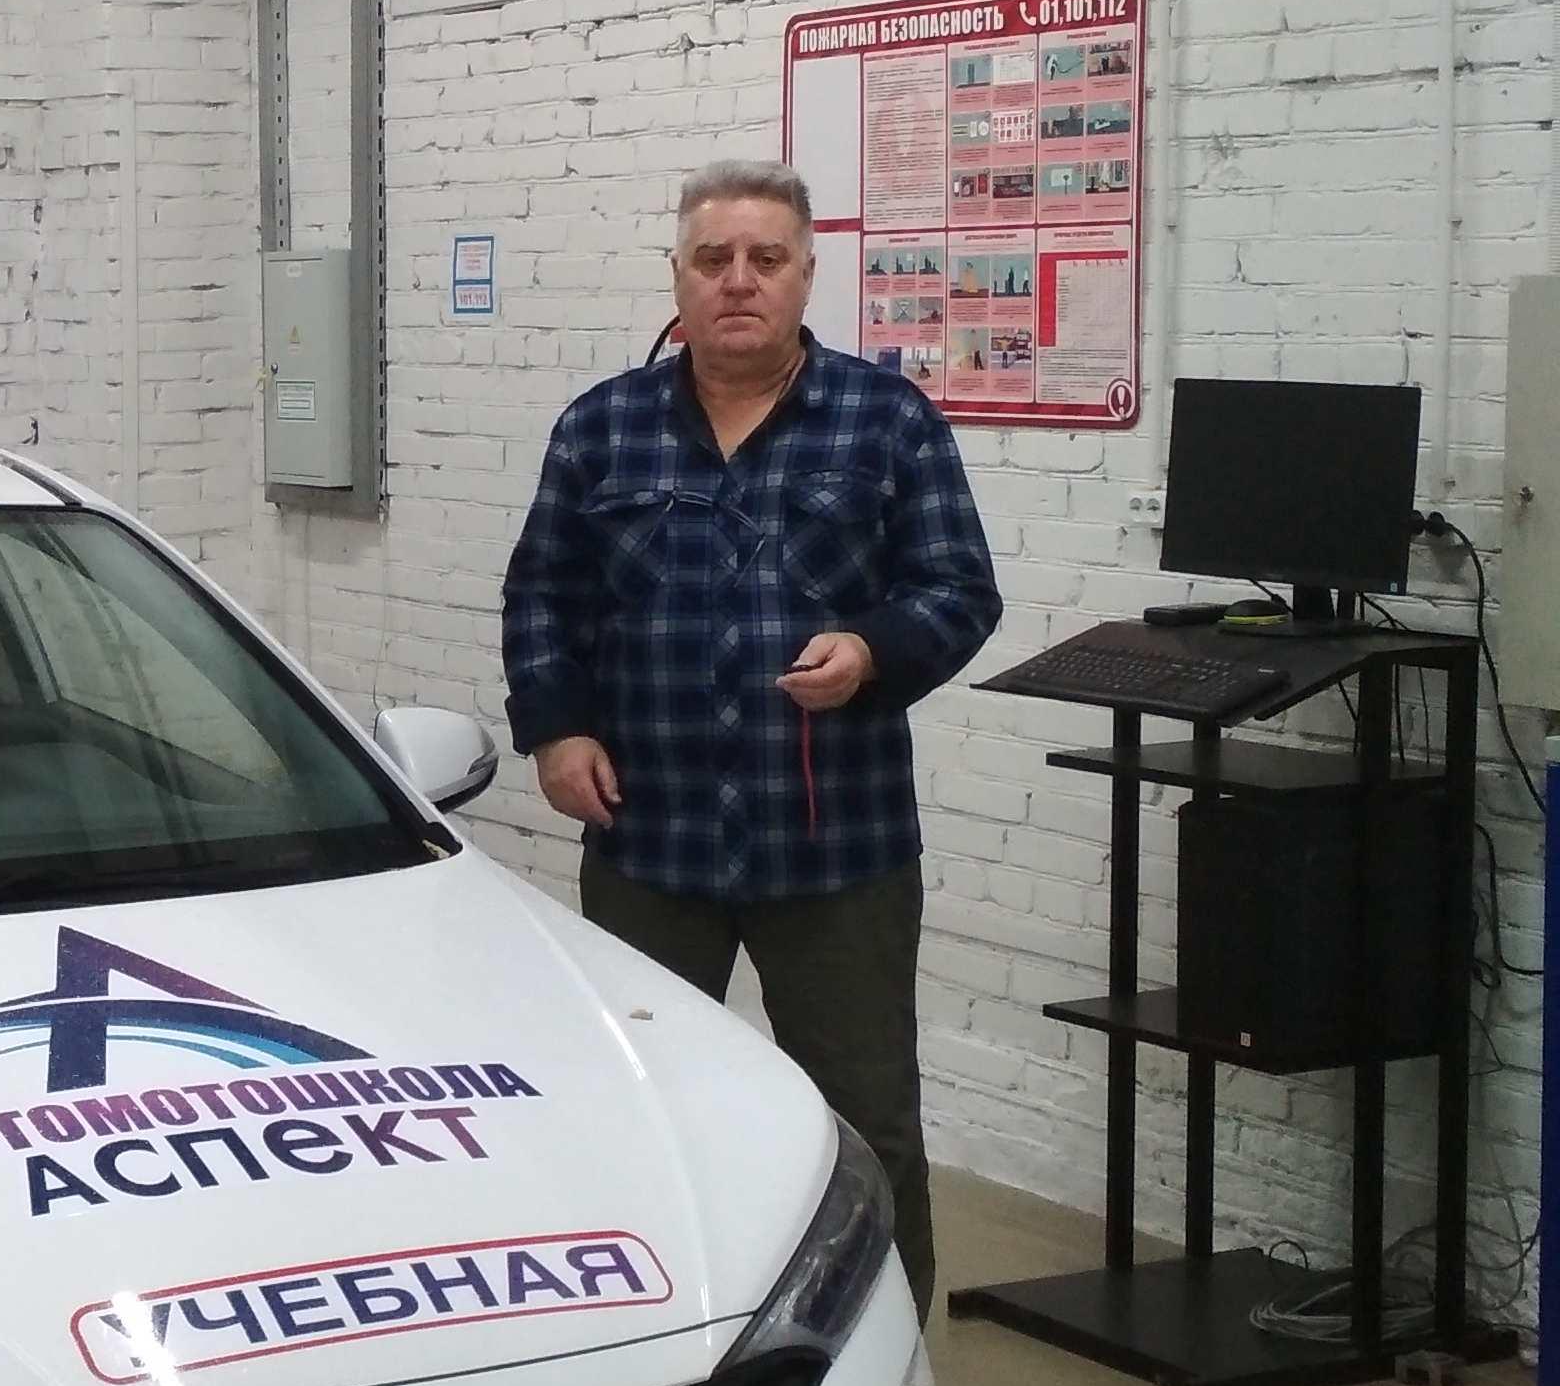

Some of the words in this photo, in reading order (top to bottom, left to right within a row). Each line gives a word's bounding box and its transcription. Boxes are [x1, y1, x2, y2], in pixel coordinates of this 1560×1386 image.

[799, 22, 877, 54] ПОЖАРНАЯ
[880, 5, 1004, 43] БЕЗОПАСНОСТЬ
[100, 1242, 647, 1369] УЧЕБНАЯ
